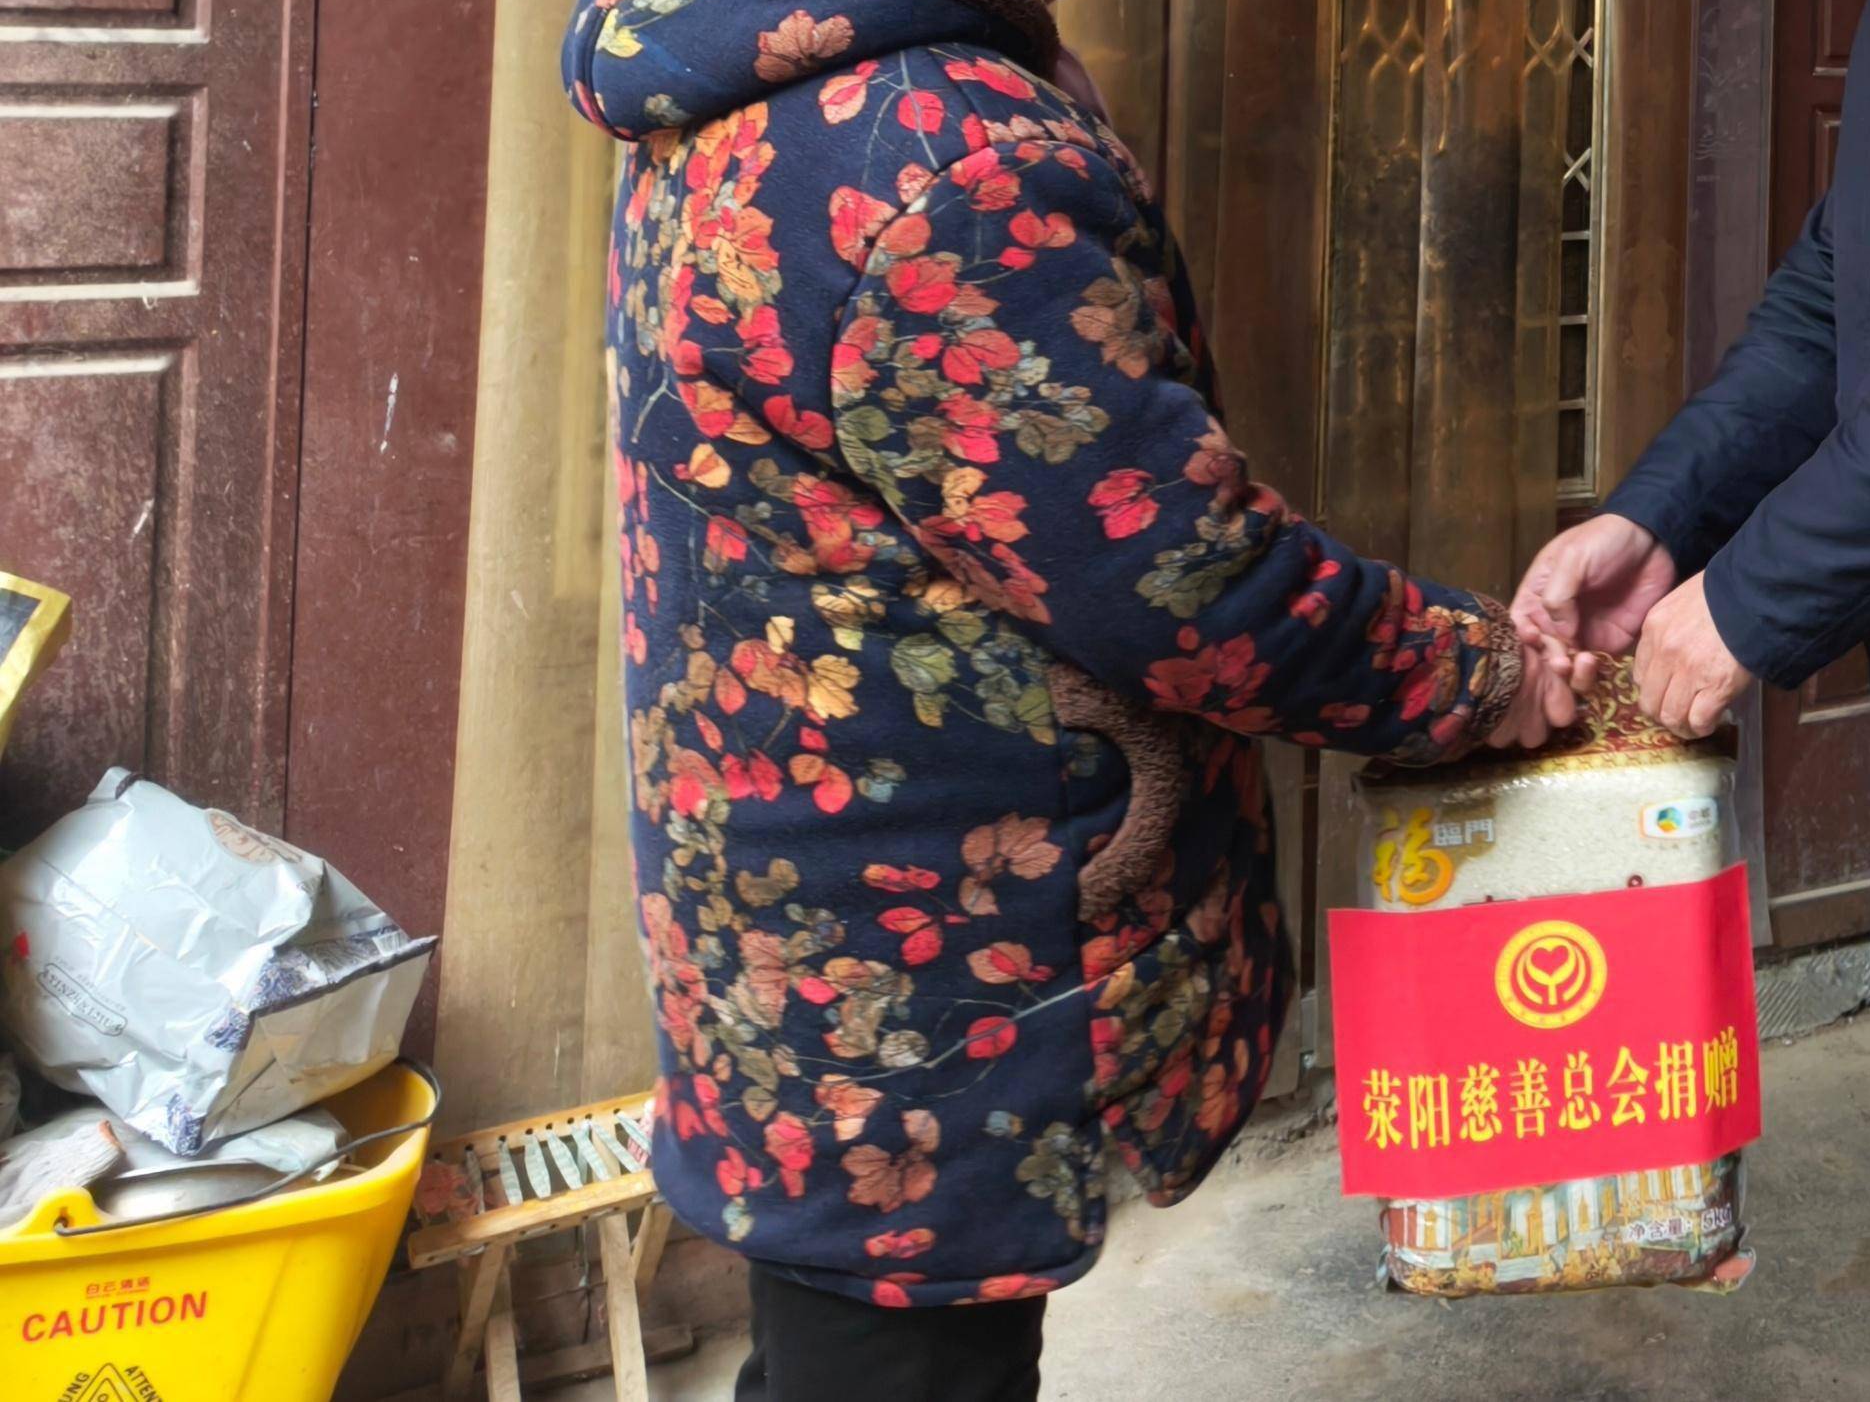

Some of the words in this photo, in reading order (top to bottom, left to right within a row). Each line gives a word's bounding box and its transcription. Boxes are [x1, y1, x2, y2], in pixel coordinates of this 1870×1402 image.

[1361, 1025, 1738, 1149] 荥阳慈善总会捐赠
[22, 1291, 207, 1342] CAUTION
